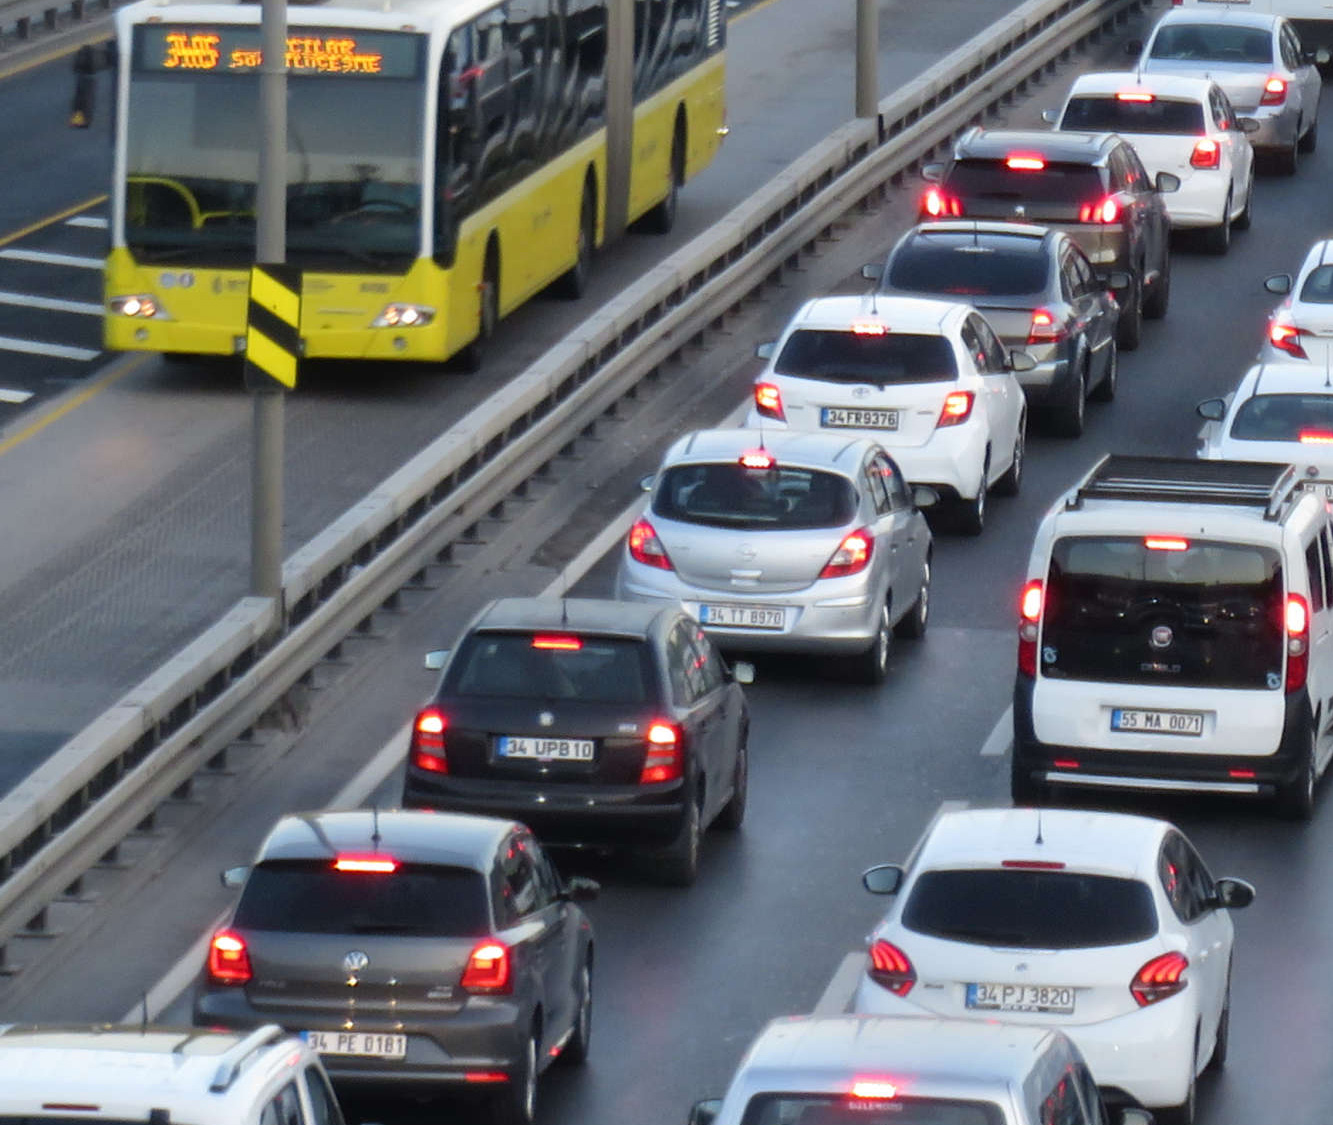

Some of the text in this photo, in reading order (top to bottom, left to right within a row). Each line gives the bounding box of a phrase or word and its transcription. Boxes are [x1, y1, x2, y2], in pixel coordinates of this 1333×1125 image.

[710, 608, 724, 623] 34
[1122, 713, 1137, 728] 55
[1169, 715, 1199, 731] 0071
[509, 739, 527, 755] 34
[977, 985, 1071, 1006] 34 PJ 3820
[309, 1033, 328, 1050] 34
[338, 1034, 357, 1052] PE
